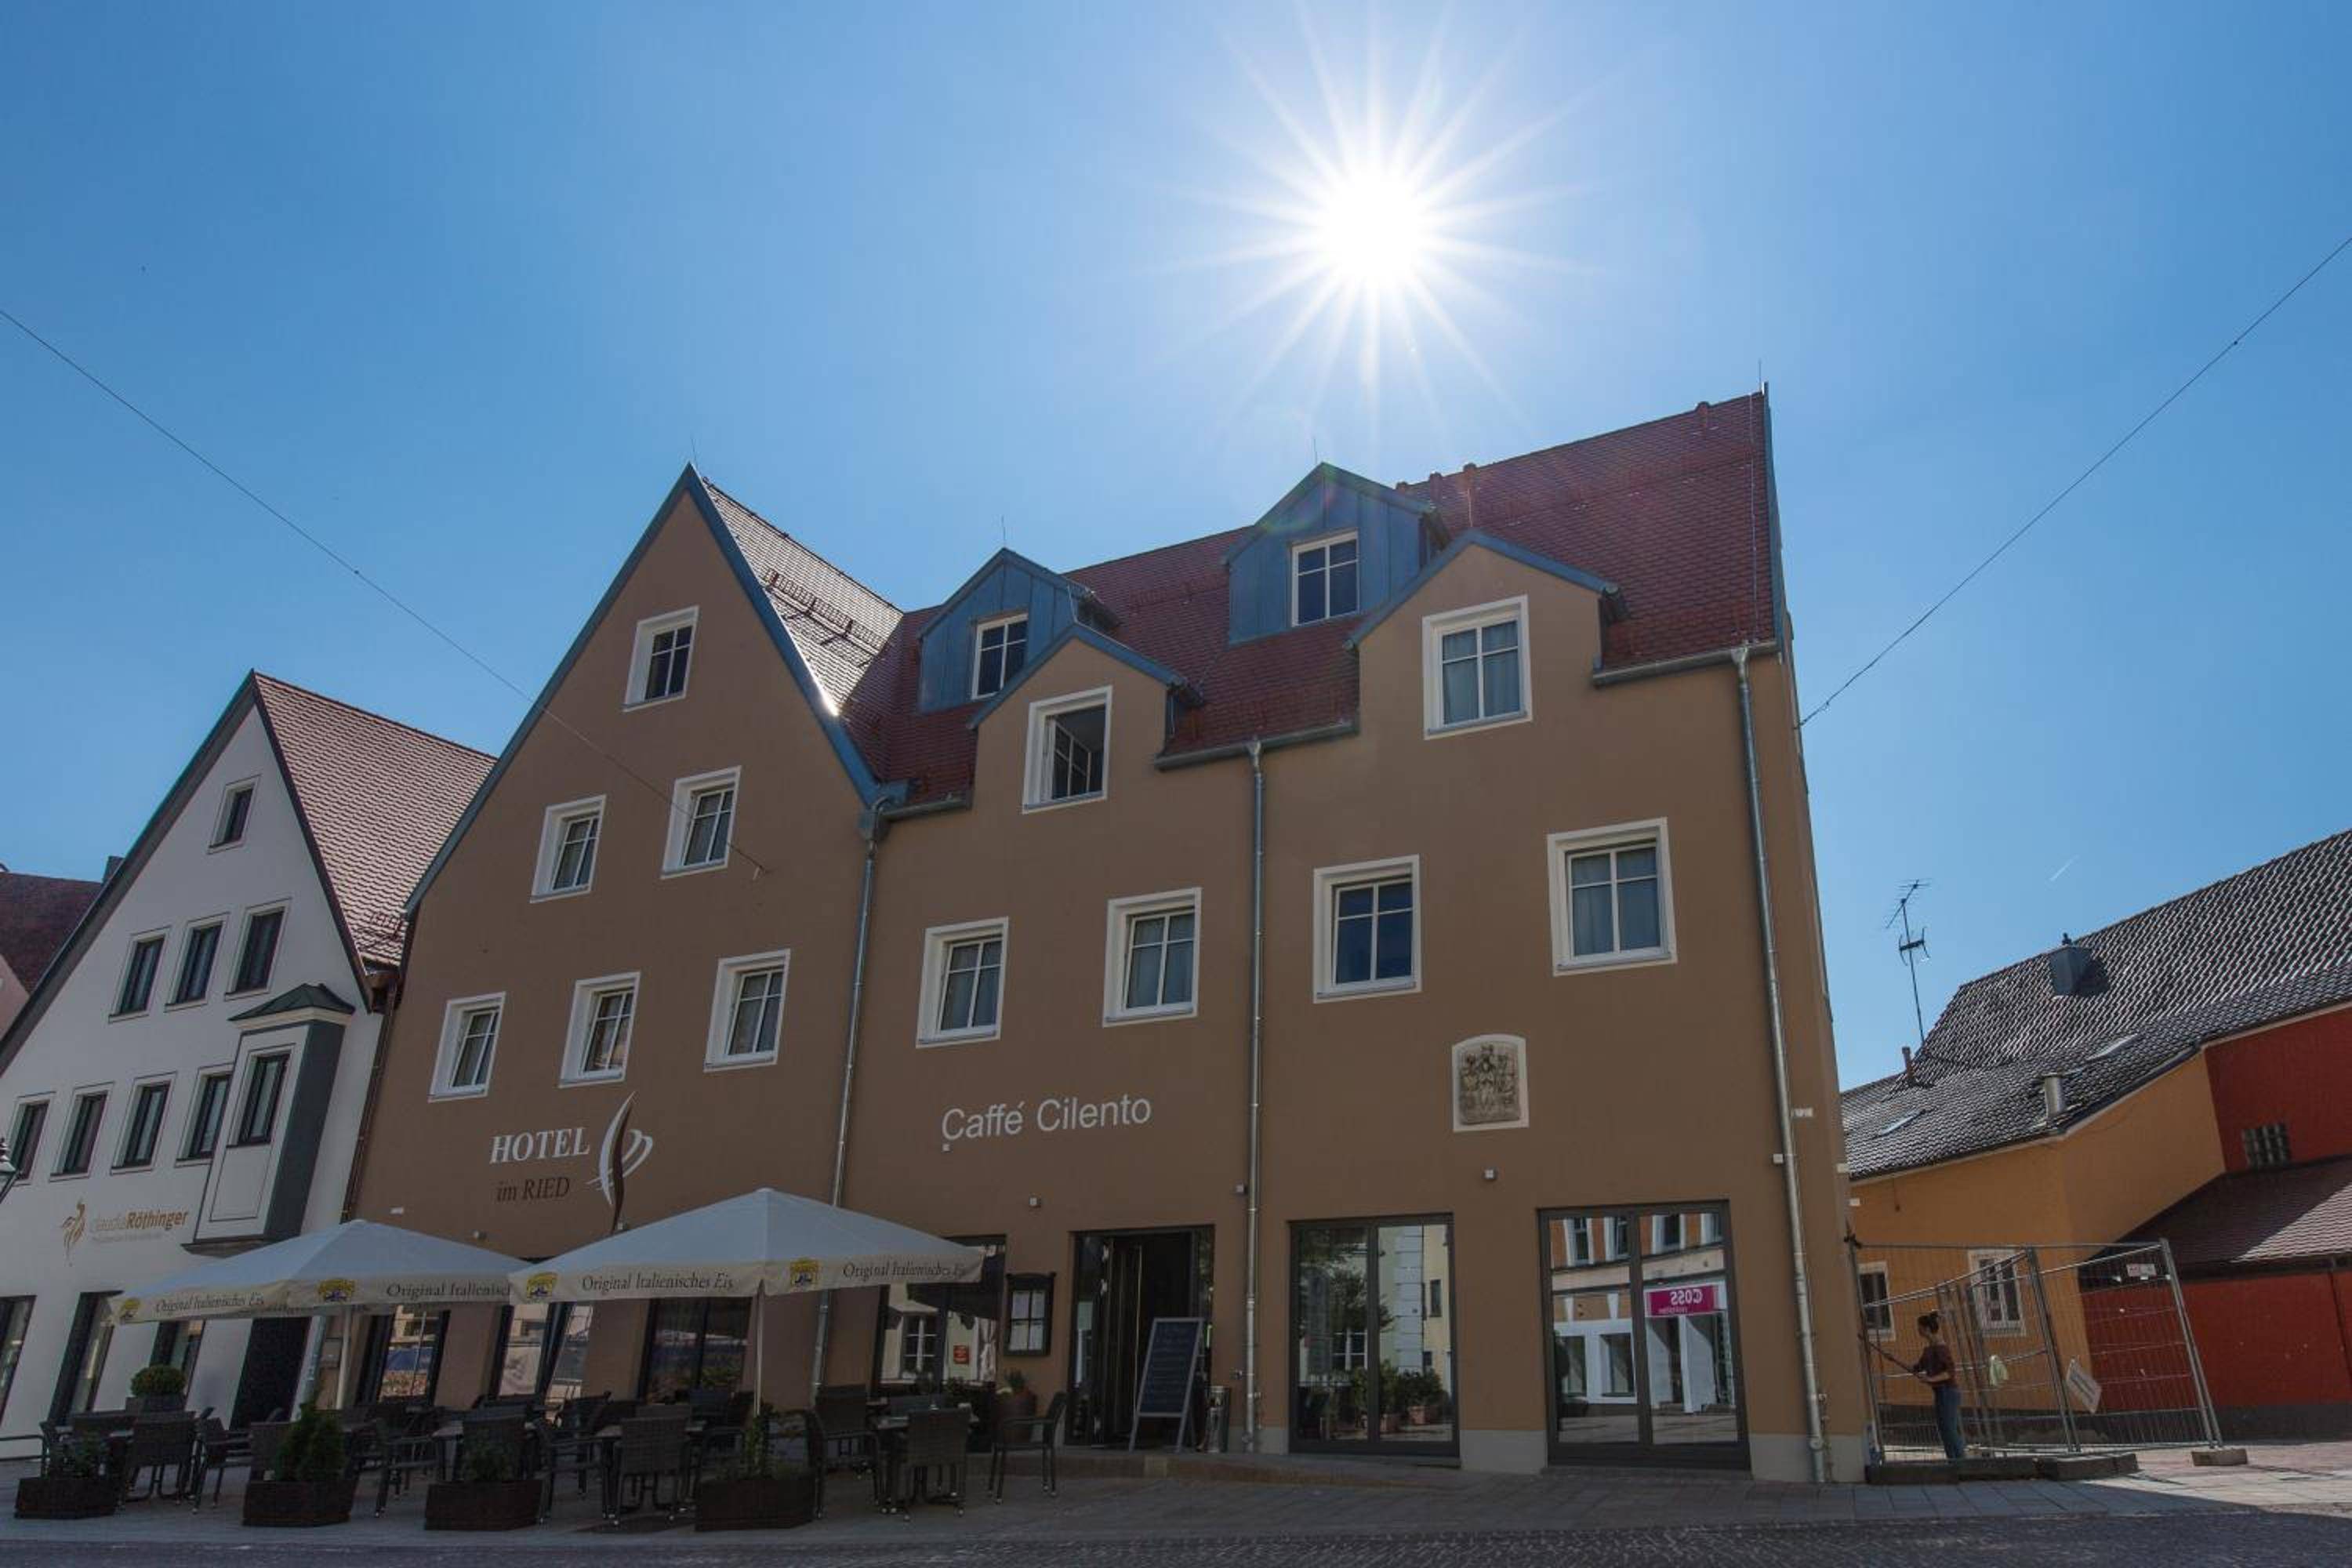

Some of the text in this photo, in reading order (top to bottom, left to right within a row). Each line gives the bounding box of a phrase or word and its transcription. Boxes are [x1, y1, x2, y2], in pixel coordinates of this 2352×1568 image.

[942, 1094, 1152, 1140] Caffé Cilento
[488, 1127, 590, 1164] HOTEL
[495, 1177, 570, 1202] im RIED
[843, 1260, 890, 1281] Original
[387, 1282, 445, 1300] Original
[583, 1272, 630, 1294] Original
[636, 1272, 710, 1290] Italienisches
